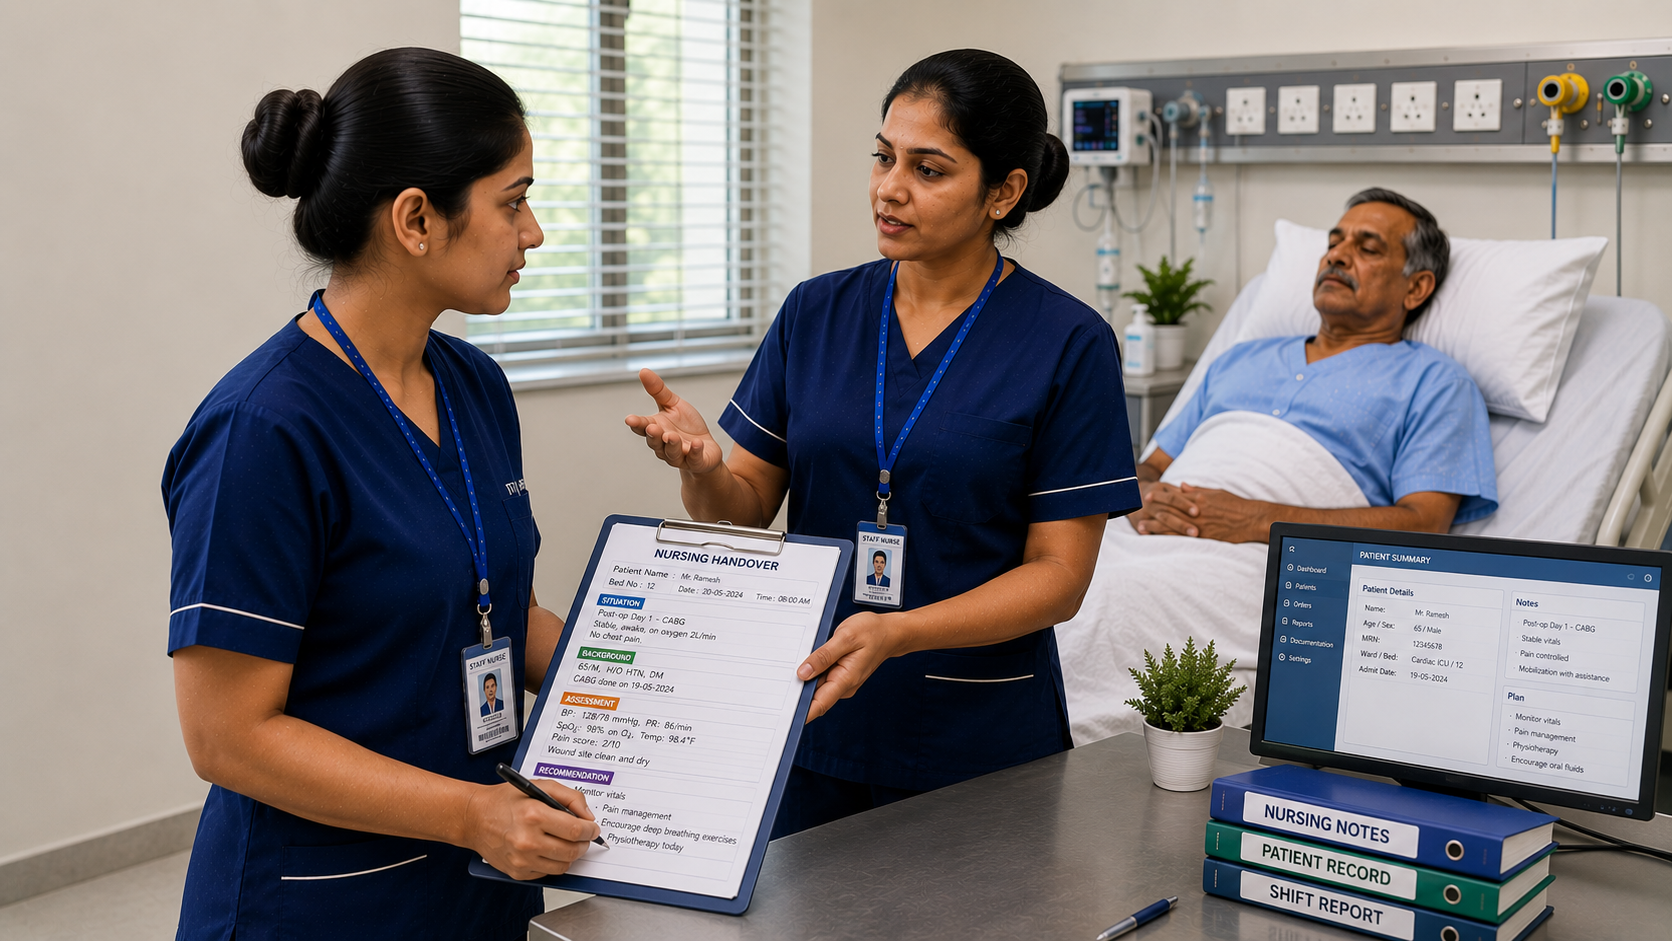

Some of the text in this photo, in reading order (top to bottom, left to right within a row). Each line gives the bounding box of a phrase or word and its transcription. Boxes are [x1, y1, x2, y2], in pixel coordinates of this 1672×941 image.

[654, 549, 779, 570] NURSING HANDOVER
[1360, 551, 1431, 564] PATIENT SUMMARY
[613, 565, 642, 575] Patient
[644, 569, 668, 578] Name
[693, 574, 720, 583] Ramesh
[1297, 566, 1327, 574] Dashboard
[609, 578, 624, 586] Bed
[702, 588, 743, 598] 20-05-2024
[1363, 585, 1414, 596] Patient Details
[601, 597, 640, 607] SITUATION
[1516, 598, 1539, 607] Notes
[598, 609, 628, 620] Post-op
[631, 613, 646, 622] Day
[662, 617, 686, 625] CABG
[1365, 604, 1385, 613] Name:
[1426, 610, 1449, 619] Ramesh
[594, 620, 618, 631] Stable,
[661, 630, 688, 638] oxygen
[690, 632, 716, 640] 2L/min
[1292, 619, 1313, 628] Reports
[1363, 620, 1376, 629] Age
[1550, 622, 1562, 631] Day
[1575, 624, 1596, 633] CABG
[624, 636, 642, 644] pain.
[1290, 637, 1334, 648] Documentation
[1362, 635, 1442, 650] MRN: 12345678
[1522, 635, 1542, 643] Stable
[582, 650, 631, 661] BACKGROUND
[1289, 655, 1311, 664] Settings
[1360, 650, 1378, 658] Ward
[1412, 656, 1435, 666] Cardiac
[1520, 650, 1569, 662] Pain controlled
[578, 663, 664, 679] 65/M, H/O HTN, DM
[1359, 666, 1448, 682] Admit Date: 19-05-2024
[1519, 665, 1558, 676] Mobilization
[1575, 673, 1610, 682] assistance
[573, 675, 596, 684] CABG
[598, 678, 617, 687] done
[632, 682, 674, 693] 19-05-2024
[564, 695, 615, 708] ASSESSMENT
[1508, 692, 1525, 701] Plan
[561, 709, 576, 717] BP:
[645, 719, 660, 728] PR:
[664, 721, 692, 732] 86/min
[1515, 713, 1542, 722] Monitor
[551, 733, 621, 748] Pain score: 2/10
[587, 724, 604, 734] 98%
[640, 732, 664, 743] Temp:
[1514, 727, 1576, 742] Pain management
[548, 746, 576, 756] Wound
[578, 750, 592, 758] site
[595, 752, 616, 762] clean
[636, 758, 650, 767] dry
[1511, 756, 1548, 769] Encourage
[1565, 764, 1584, 773] fluids
[538, 766, 610, 782] RECOMMENDATION
[606, 790, 626, 800] vitals
[602, 804, 672, 821] Pain management
[601, 818, 737, 845] Encourage deep breathing exercises
[1264, 804, 1390, 844] NURSING NOTES
[607, 833, 684, 853] Physiotherapy today
[1262, 844, 1391, 886] PATIENT RECORD
[1270, 885, 1383, 925] SHIFT REPORT
